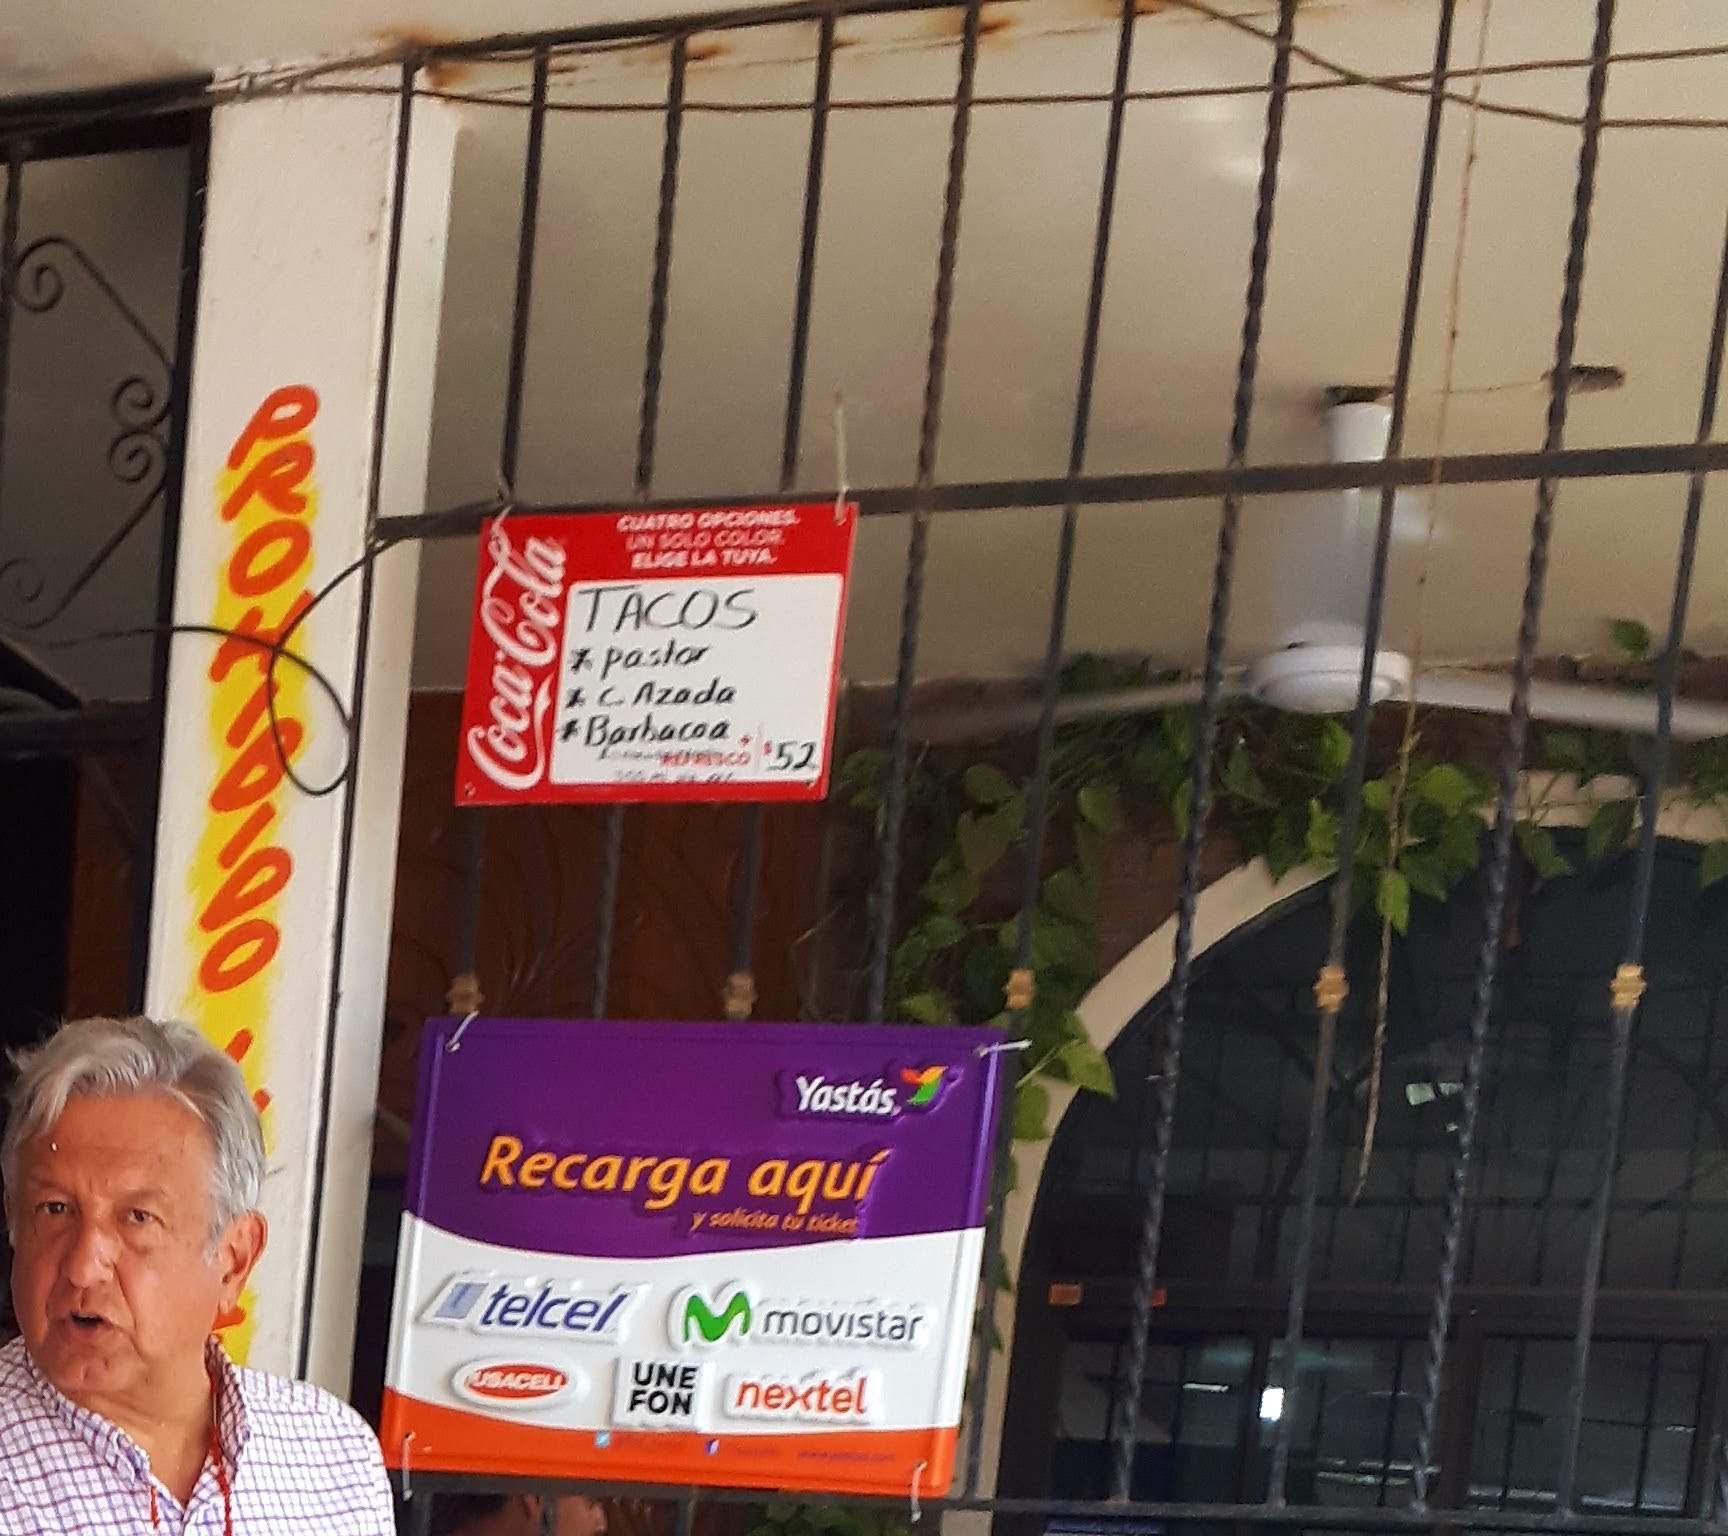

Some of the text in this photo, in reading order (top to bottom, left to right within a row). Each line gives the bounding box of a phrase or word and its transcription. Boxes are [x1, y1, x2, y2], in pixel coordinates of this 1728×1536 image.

[617, 512, 695, 532] CUATRO
[657, 530, 712, 549] SOLO
[690, 549, 718, 567] LA
[579, 585, 758, 632] TACOS
[467, 506, 567, 790] Coca-Cola
[199, 384, 320, 993] PROHIBIDO
[480, 1135, 894, 1215] Recarga aquí
[689, 1211, 708, 1234] y
[480, 1283, 924, 1342] telcel movistar
[634, 1361, 698, 1389] UNE
[627, 1390, 694, 1415] FON
[737, 1377, 870, 1416] nextel
